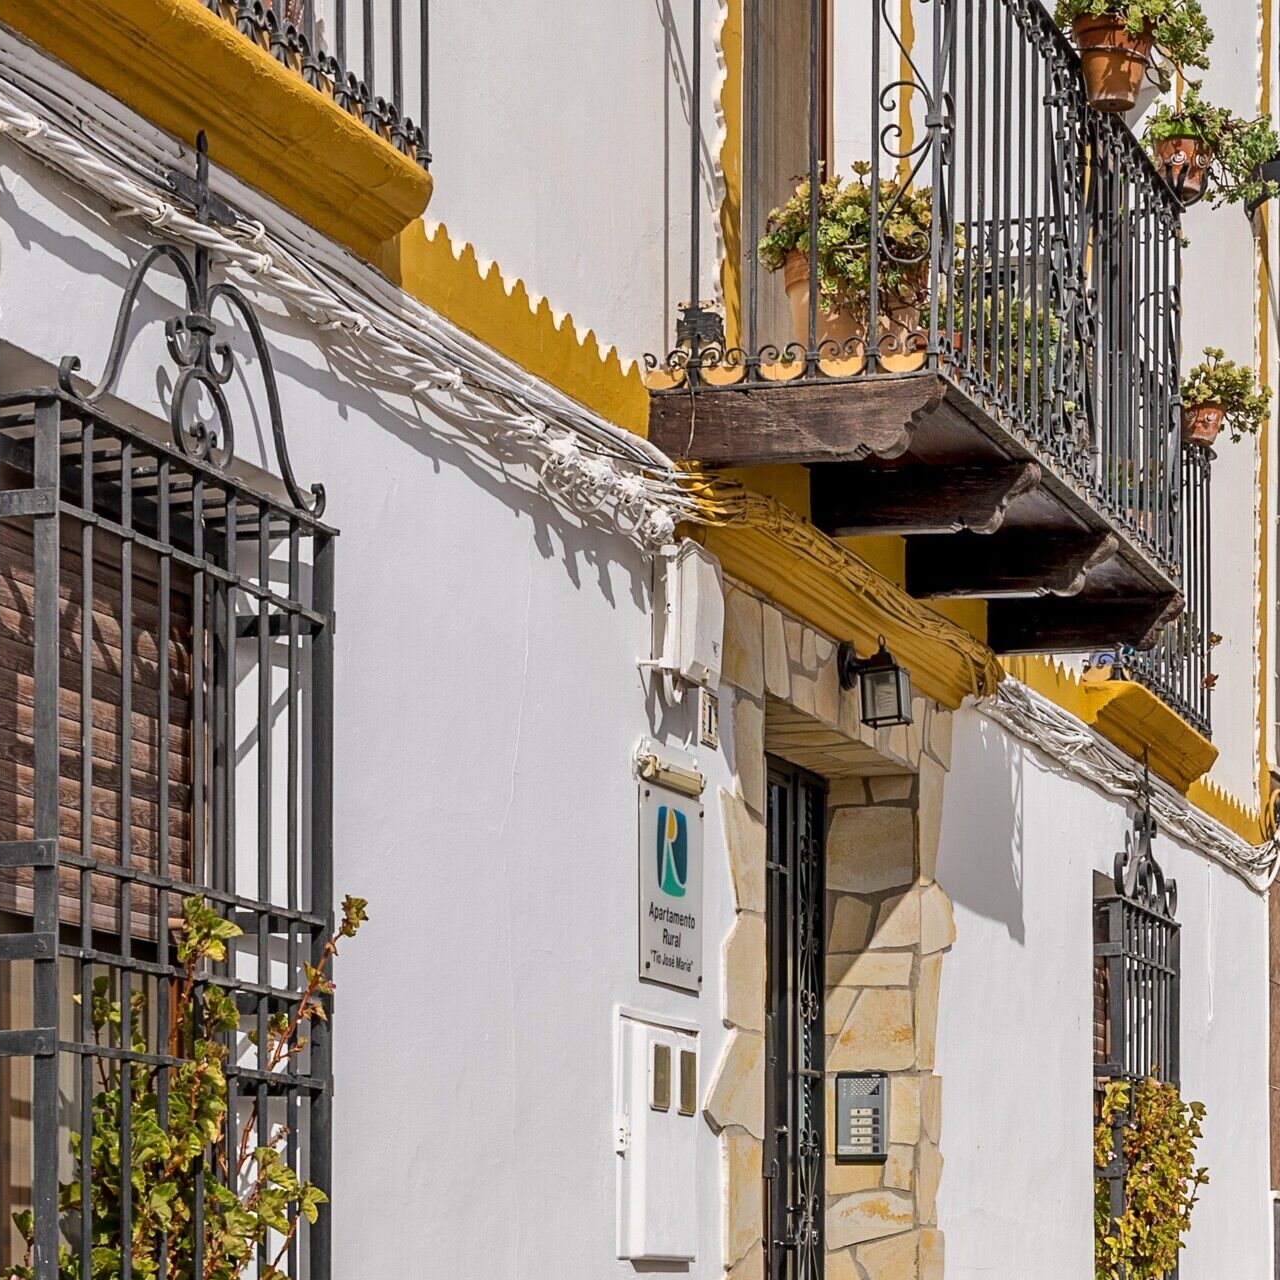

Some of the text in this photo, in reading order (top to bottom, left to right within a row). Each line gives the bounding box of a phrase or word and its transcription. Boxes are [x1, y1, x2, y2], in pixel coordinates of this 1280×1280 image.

[649, 901, 696, 930] Apartamento
[662, 928, 682, 948] Rural
[662, 953, 675, 968] José
